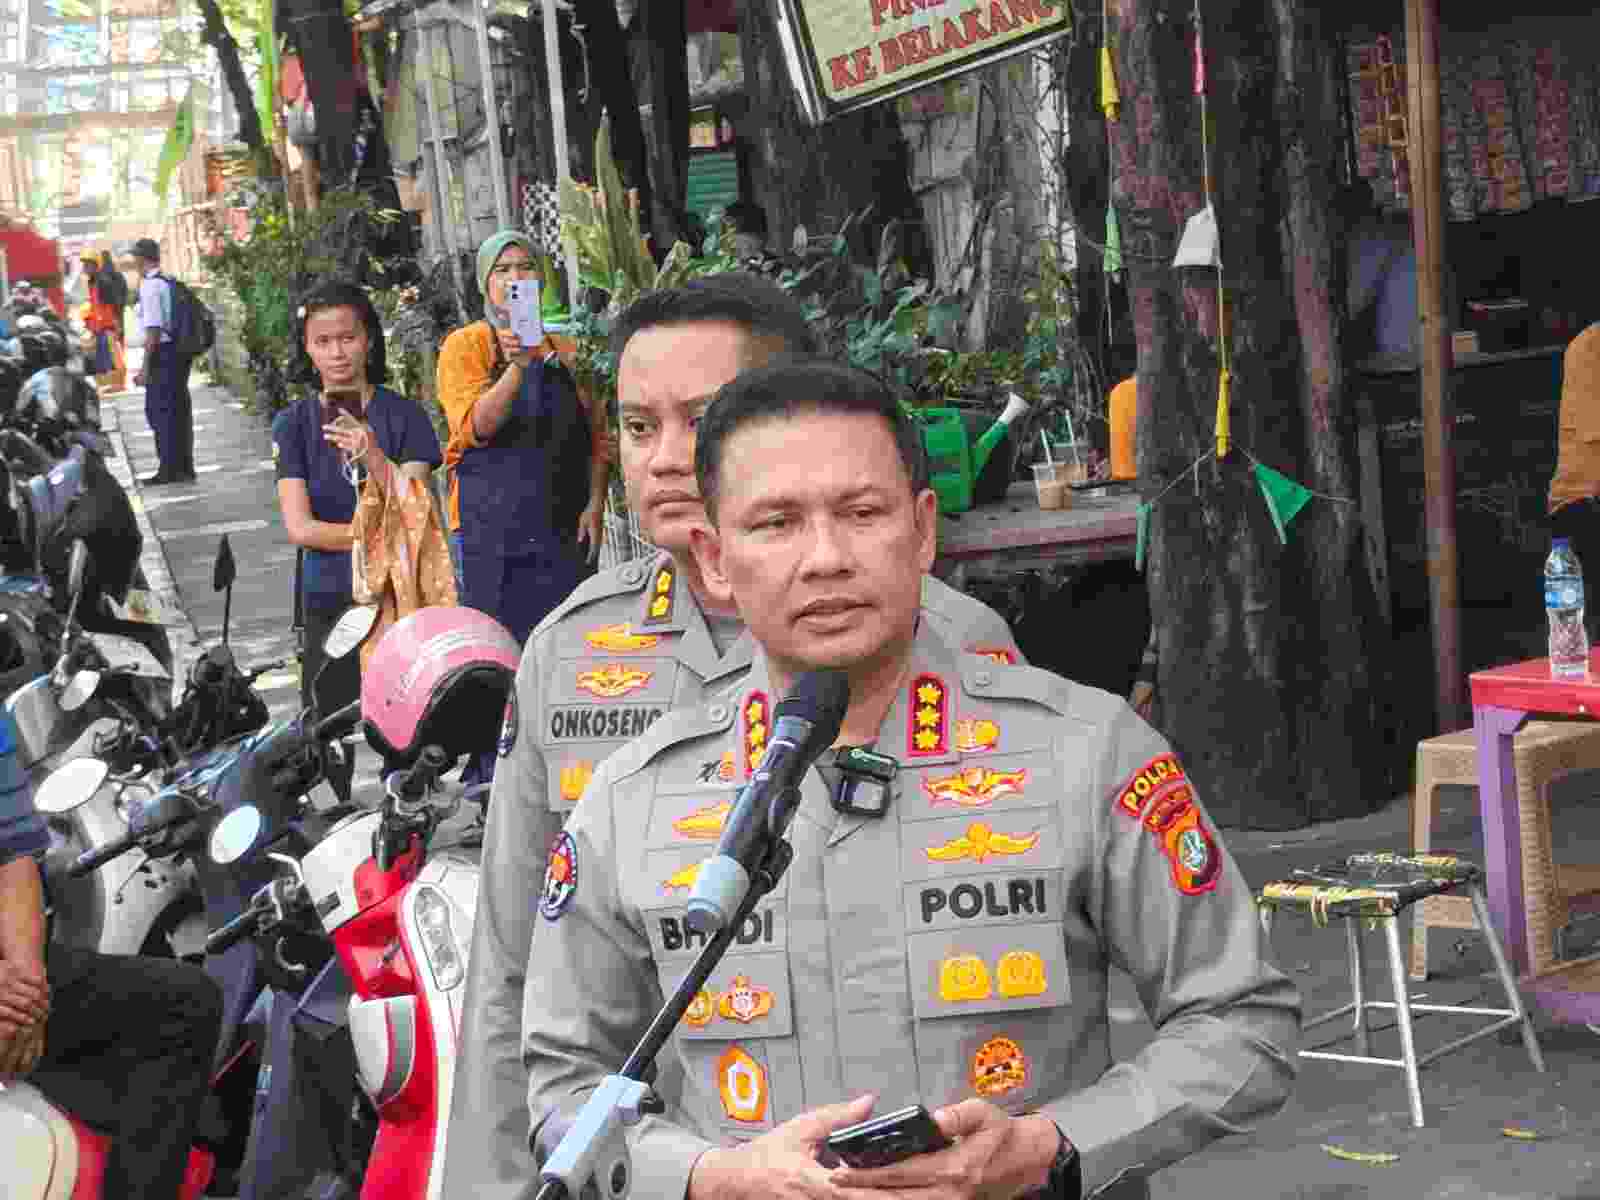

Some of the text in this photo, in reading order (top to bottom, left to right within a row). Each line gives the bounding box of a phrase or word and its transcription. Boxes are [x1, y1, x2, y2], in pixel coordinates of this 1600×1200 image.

[826, 46, 879, 91] KE
[920, 877, 1046, 923] POLRI
[660, 909, 774, 951] BHDI
